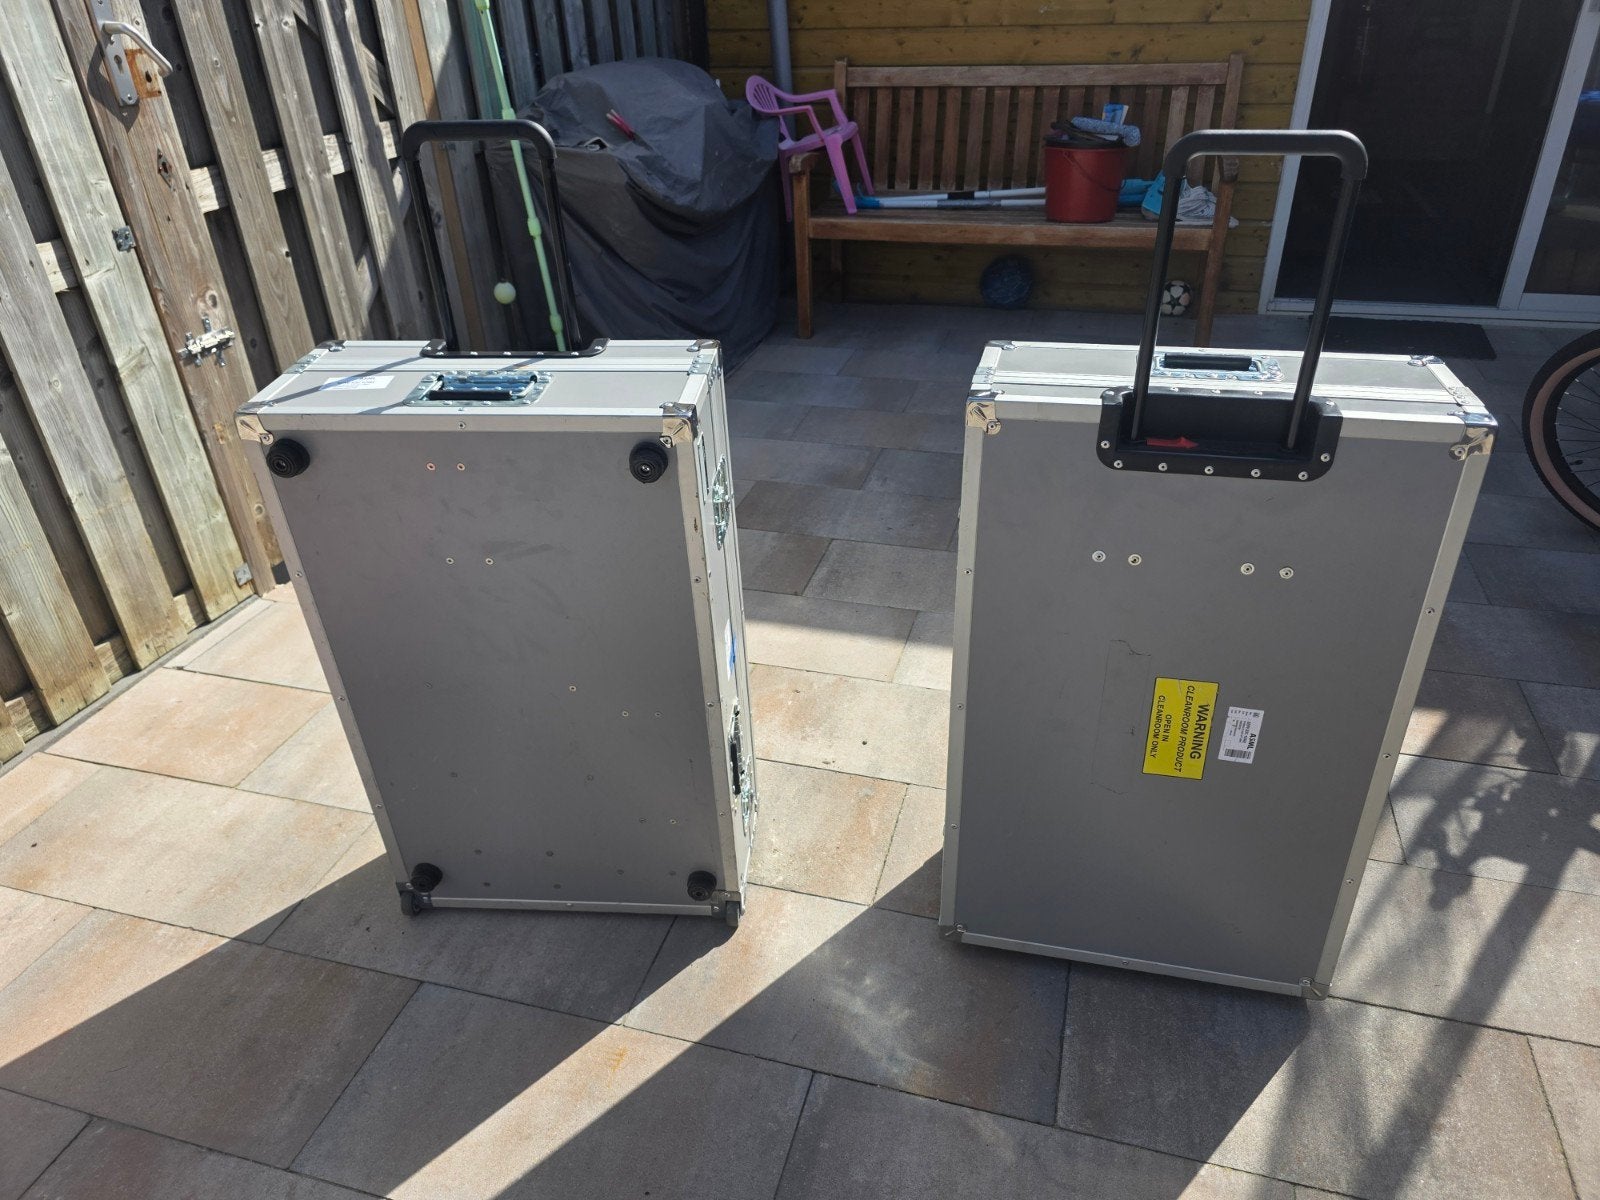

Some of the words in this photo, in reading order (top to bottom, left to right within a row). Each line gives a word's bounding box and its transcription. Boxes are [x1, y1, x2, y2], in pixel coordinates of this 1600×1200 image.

[1153, 695, 1165, 739] CLEANROOM
[1164, 714, 1172, 732] OPEN
[1180, 685, 1196, 735] CLEANROOM
[1161, 733, 1169, 742] IN
[1189, 703, 1211, 760] WARNING
[1246, 732, 1257, 750] ASML
[1150, 739, 1159, 758] ONLY
[1174, 735, 1187, 773] PRODUCT
